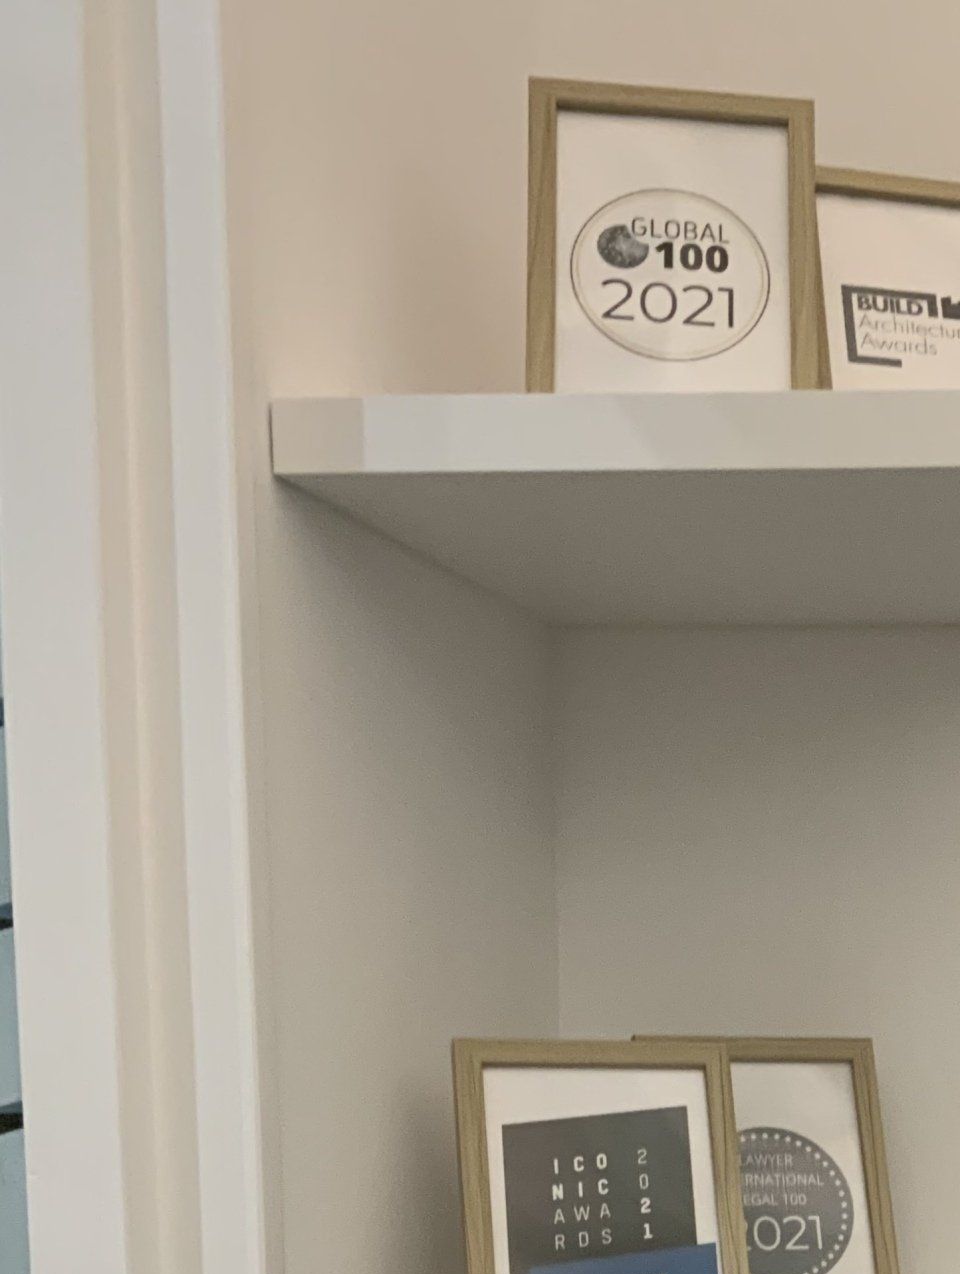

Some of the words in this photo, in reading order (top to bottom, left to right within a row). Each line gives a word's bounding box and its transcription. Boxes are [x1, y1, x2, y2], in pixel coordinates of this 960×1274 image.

[631, 216, 730, 244] GLOBAL
[655, 241, 729, 273] 100
[601, 278, 734, 328] 2021
[857, 294, 923, 315] BUILD
[861, 333, 937, 355] Awards
[743, 1172, 824, 1187] RNATIONAL
[743, 1193, 779, 1206] EGAL
[783, 1193, 807, 1206] 100
[747, 1215, 823, 1251] 021
